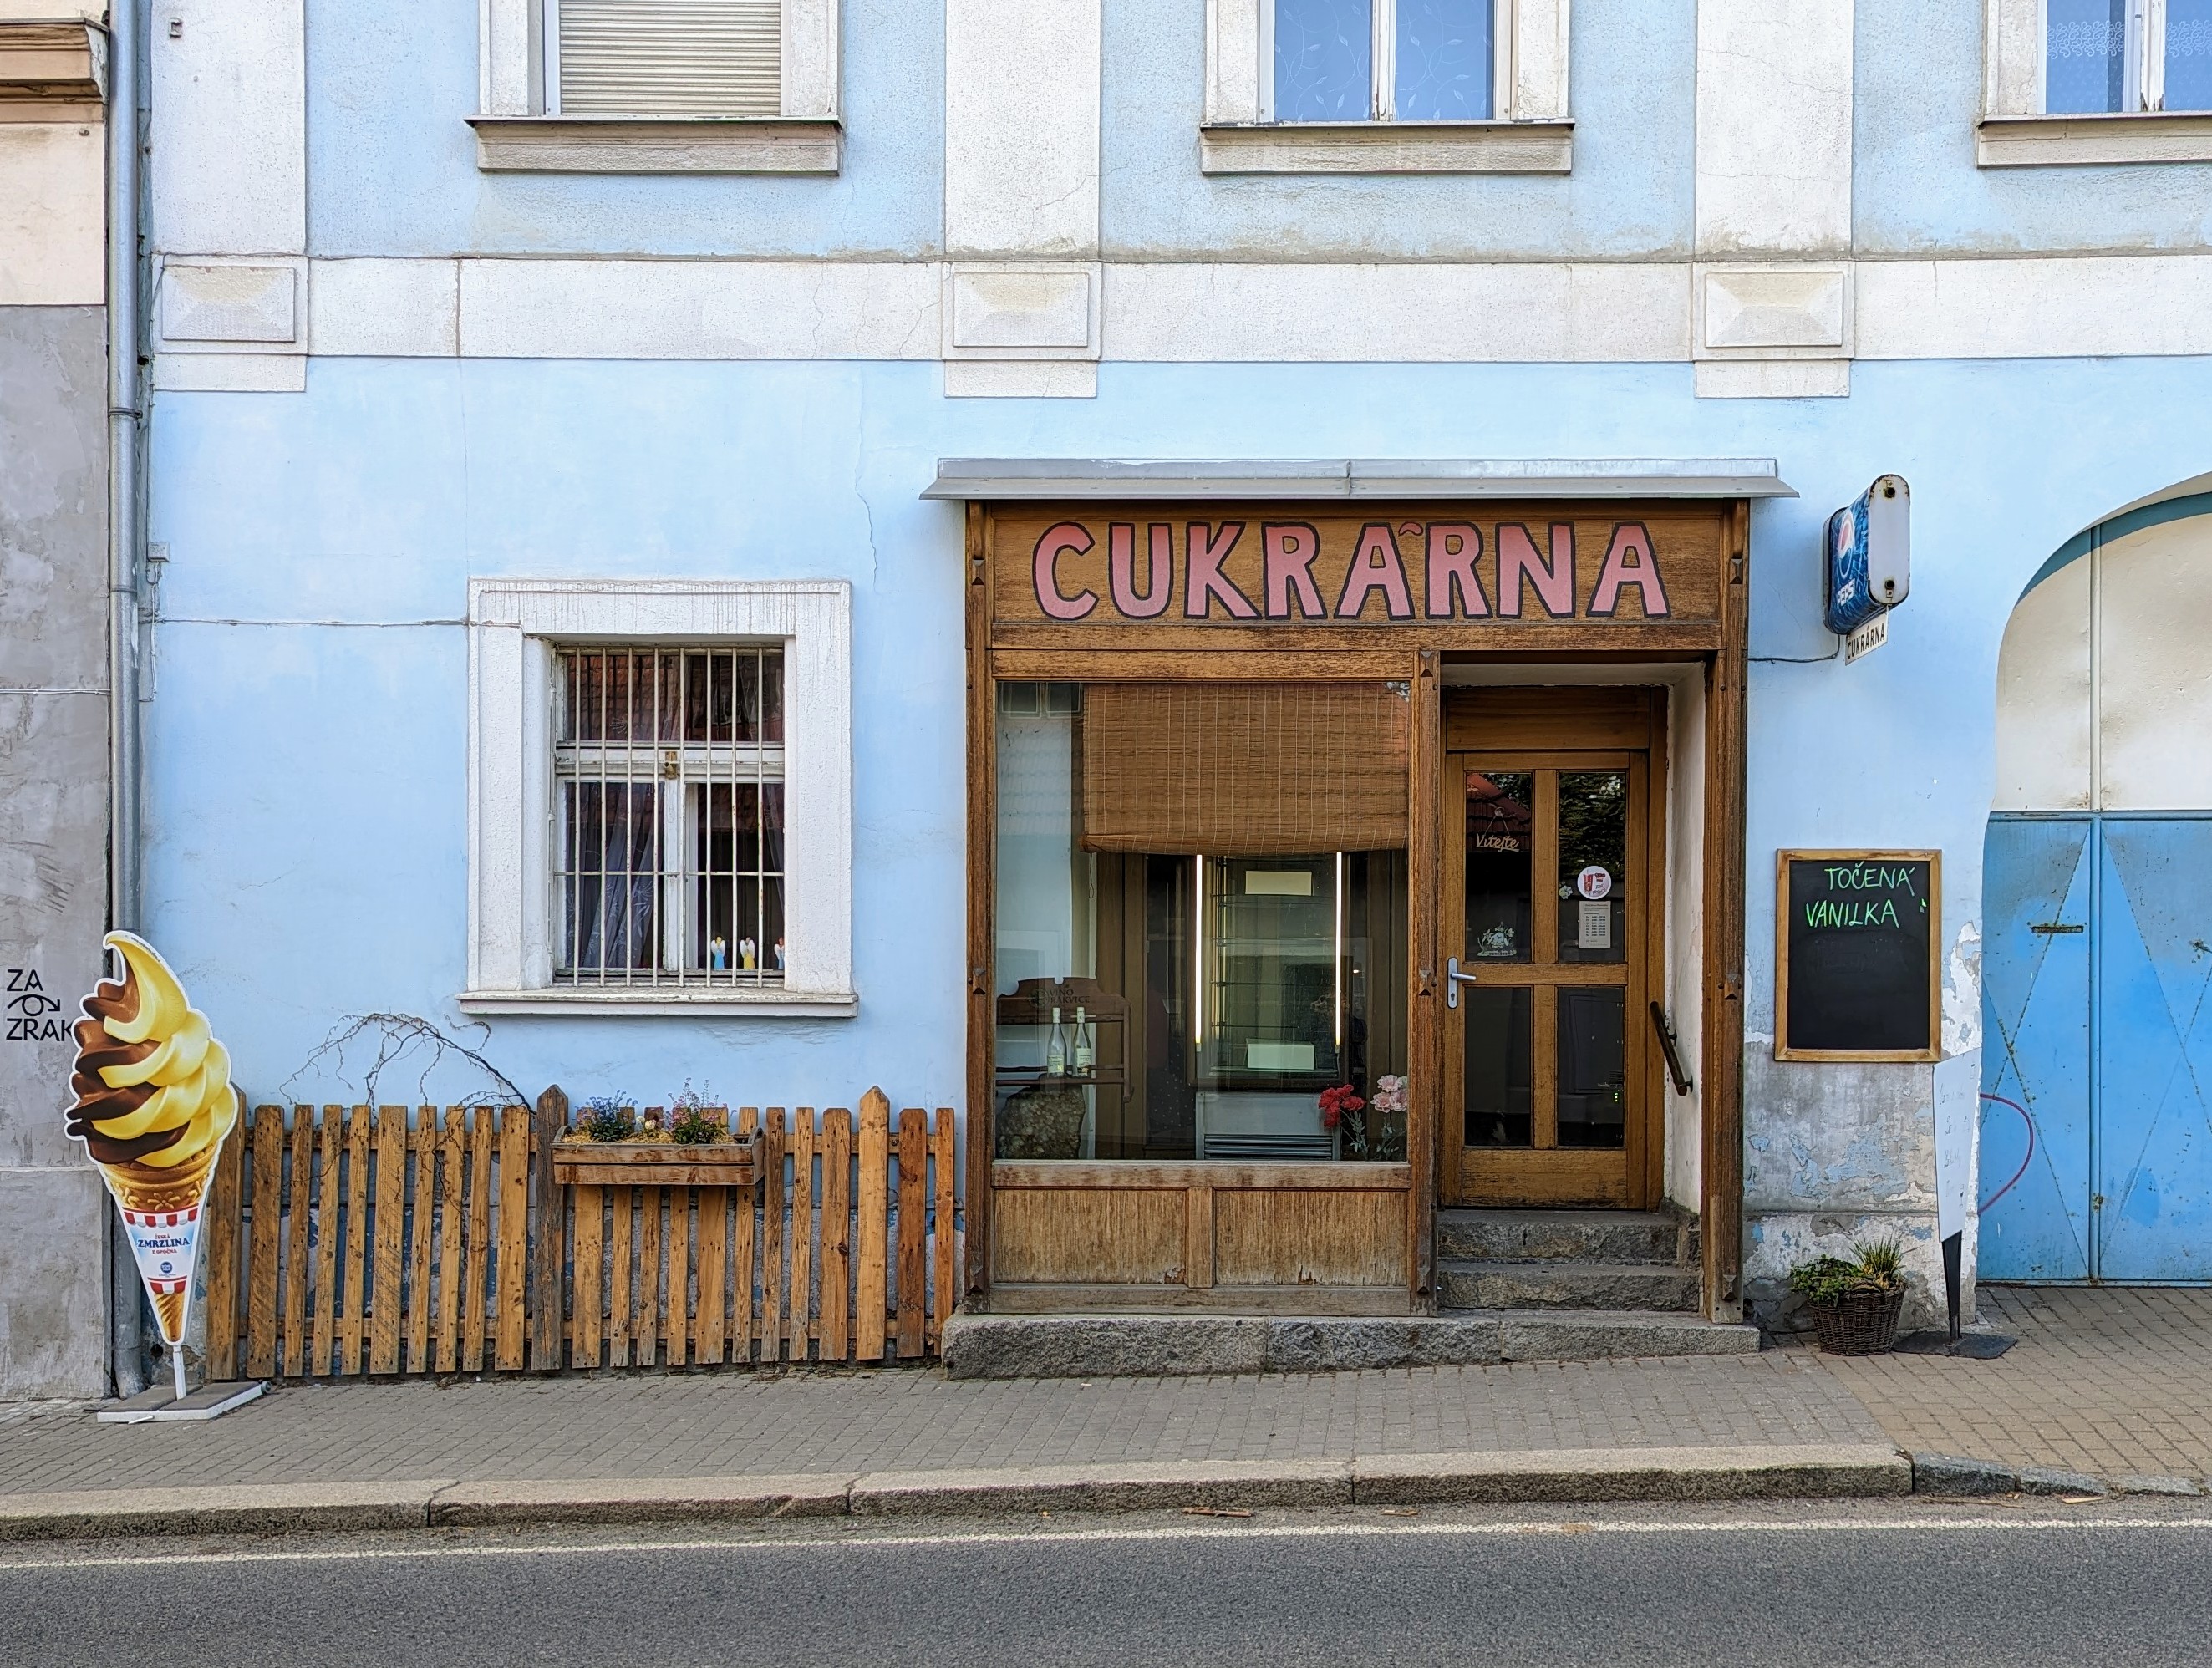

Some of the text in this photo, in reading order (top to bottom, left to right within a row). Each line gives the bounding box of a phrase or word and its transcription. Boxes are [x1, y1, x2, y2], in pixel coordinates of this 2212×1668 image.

[1847, 623, 1885, 660] CUKRÁRNA
[1824, 861, 1916, 897] TOČENÁ
[1805, 898, 1900, 928] VANILKA
[7, 969, 44, 992] ZA
[138, 1238, 190, 1248] ZMRZLINA
